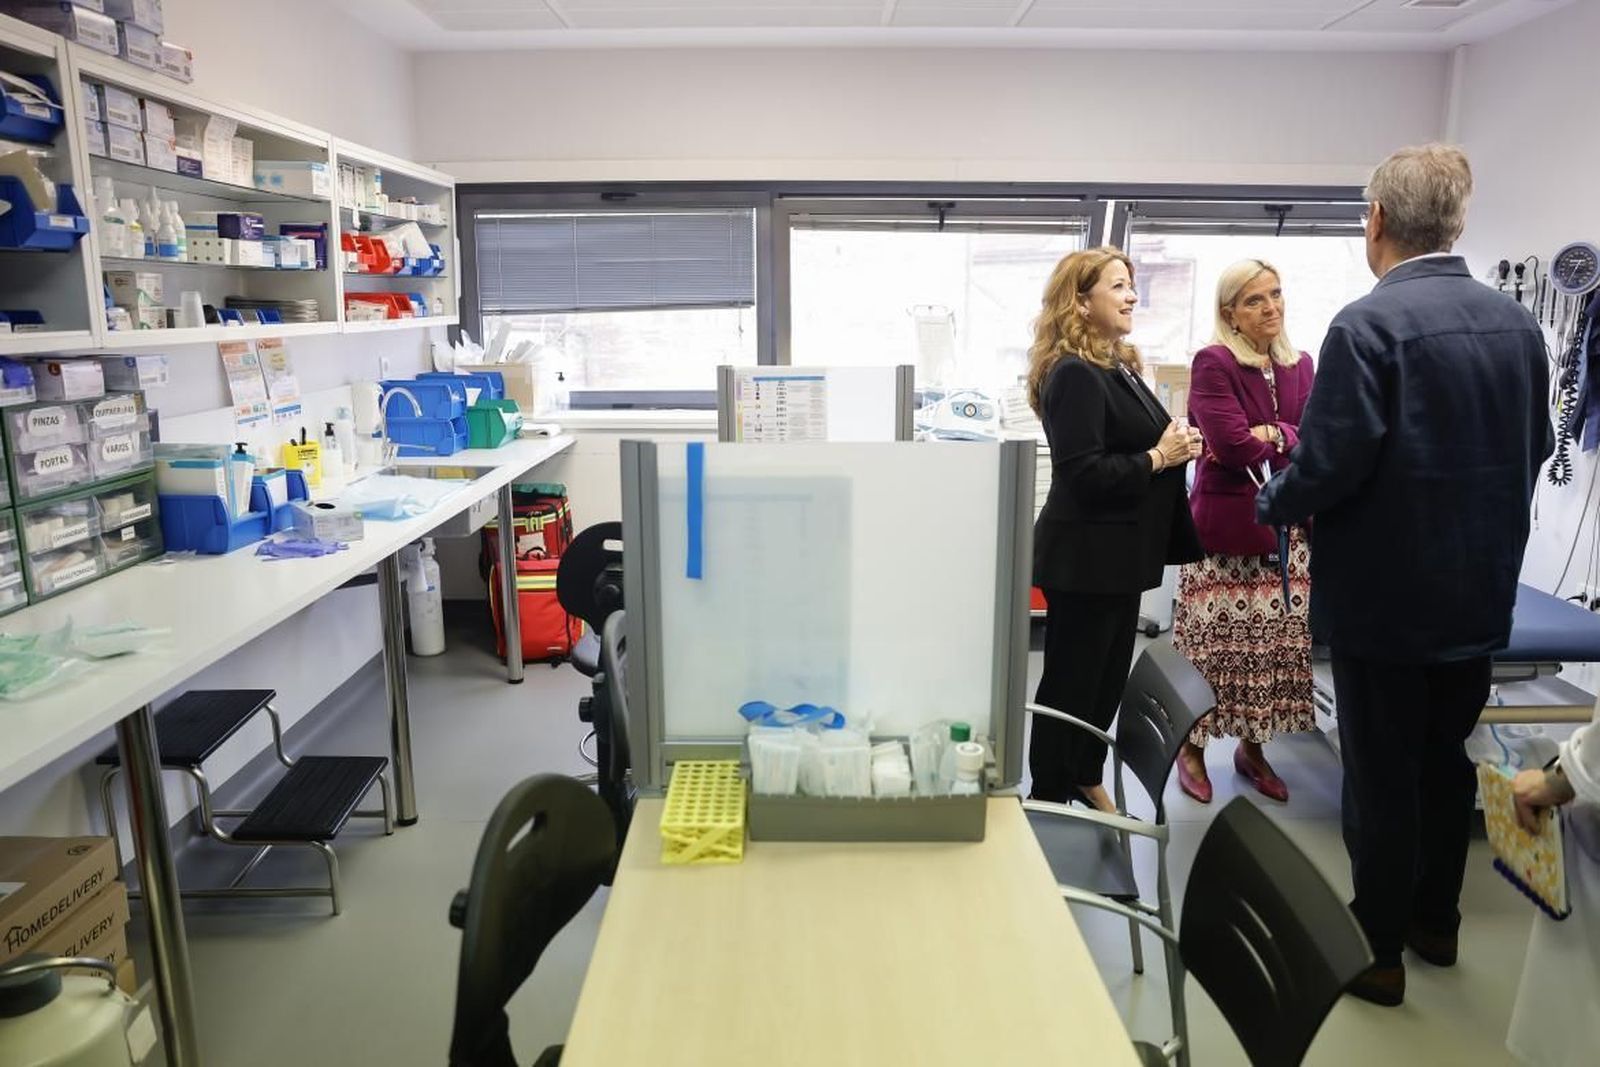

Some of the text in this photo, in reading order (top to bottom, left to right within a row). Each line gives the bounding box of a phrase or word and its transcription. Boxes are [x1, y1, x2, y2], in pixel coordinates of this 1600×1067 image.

[32, 415, 60, 426] PINZAS
[106, 443, 130, 454] VARIOS
[40, 454, 69, 468] PORTAS
[3, 867, 105, 953] HOMEDELIVERY
[59, 911, 115, 957] ELIVERY
